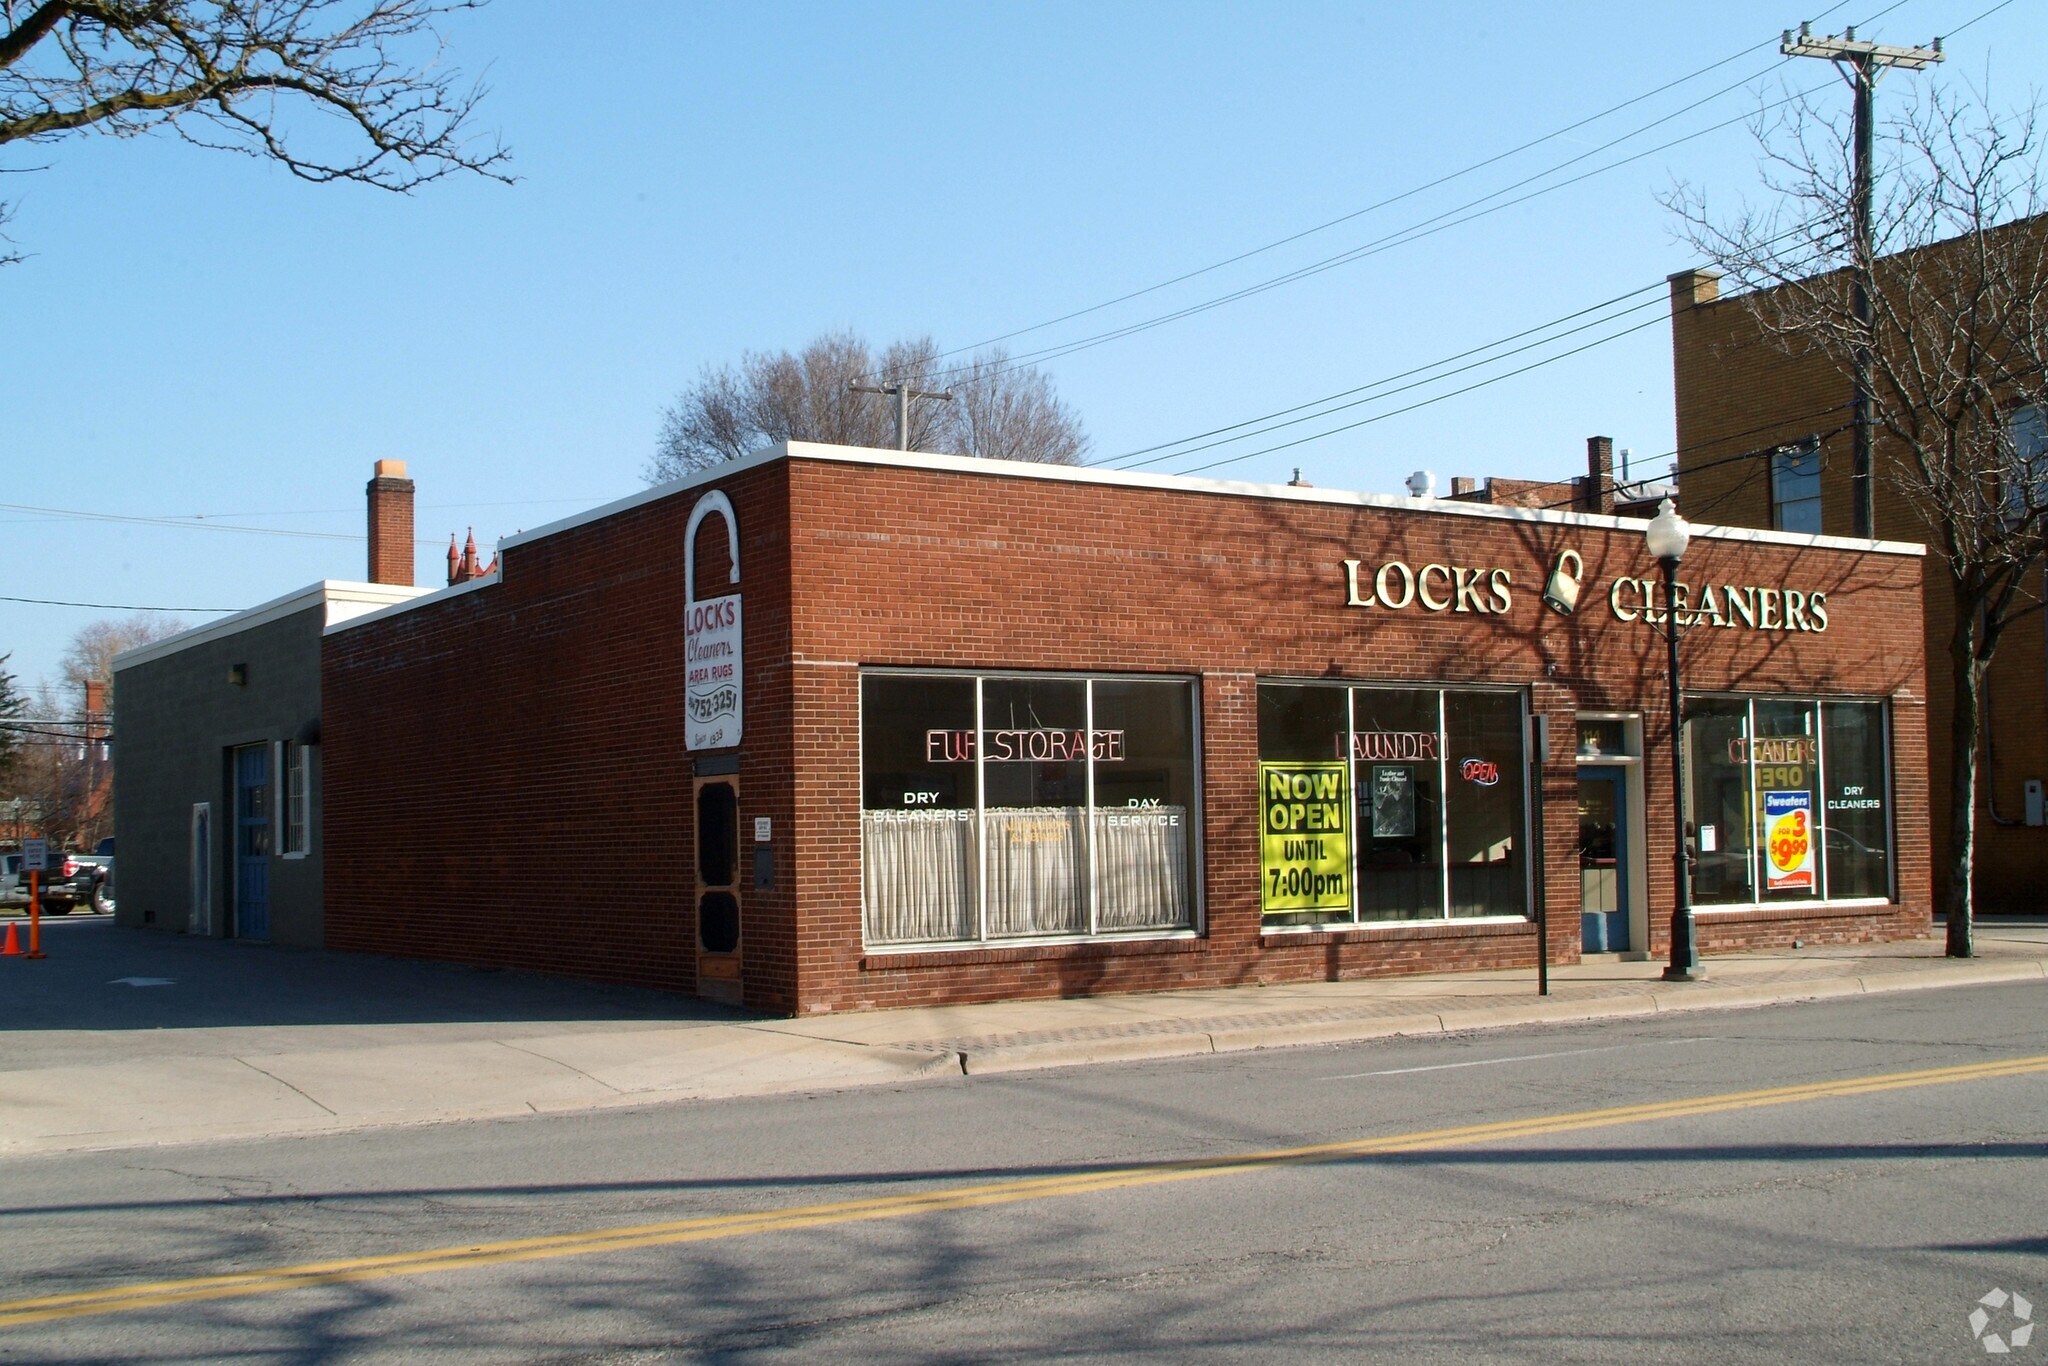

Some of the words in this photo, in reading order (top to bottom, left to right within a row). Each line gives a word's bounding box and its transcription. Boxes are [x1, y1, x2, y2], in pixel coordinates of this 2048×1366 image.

[1343, 559, 1512, 614] LOCKS
[1611, 576, 1828, 632] CLEANERS
[686, 600, 735, 636] LOCK'S
[687, 637, 733, 662] Cleaners
[689, 668, 708, 683] AREA
[712, 664, 733, 680] RUGS
[995, 731, 1123, 761] STORAGE
[1462, 762, 1498, 782] OPEN
[1270, 774, 1339, 800] NOW
[1844, 786, 1864, 796] DRY
[904, 792, 940, 804] DRY
[1128, 798, 1160, 809] DAY
[1767, 795, 1808, 808] Sweaters
[1827, 799, 1881, 810] CLEANERS
[873, 810, 969, 823] CLEANERS
[1108, 815, 1179, 827] SERVICE
[1270, 803, 1340, 830] OPEN
[1792, 810, 1806, 838] 3
[1778, 827, 1791, 835] FOR
[1284, 840, 1327, 861] UNTIL
[1269, 867, 1343, 902] 7:00pm
